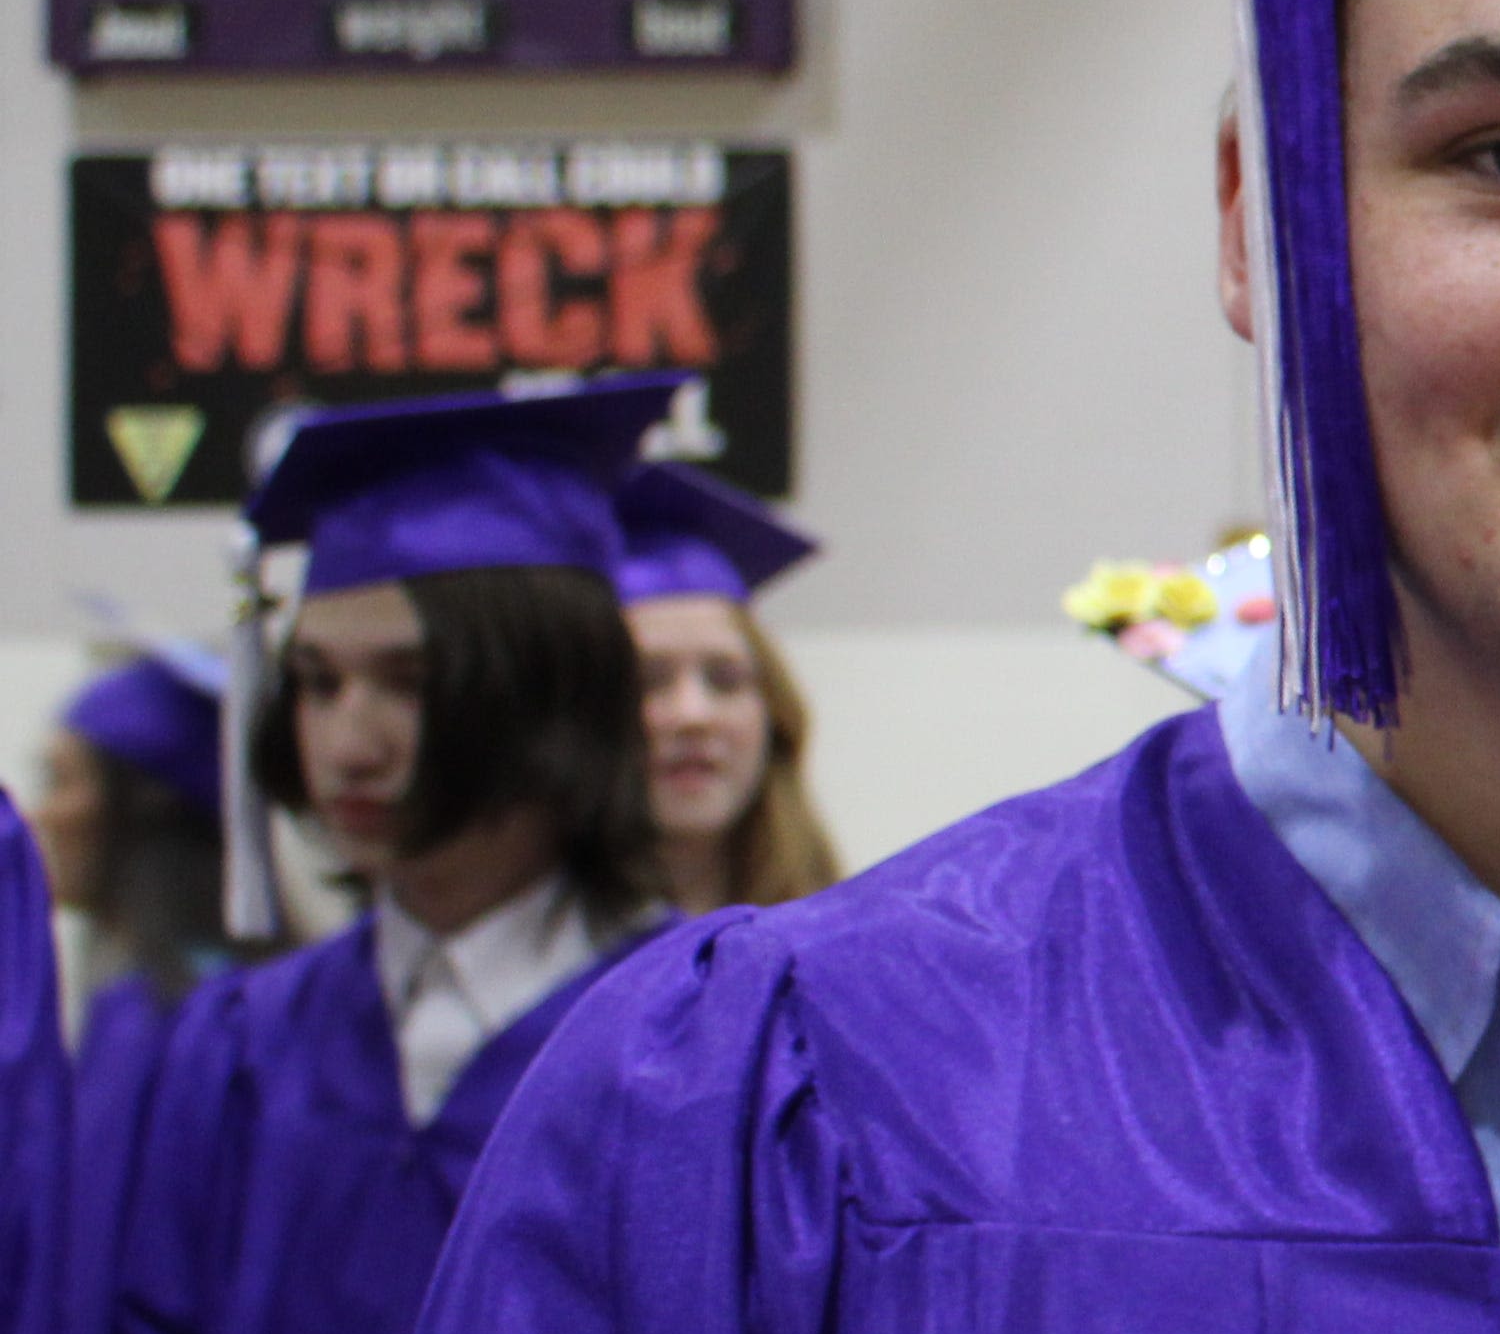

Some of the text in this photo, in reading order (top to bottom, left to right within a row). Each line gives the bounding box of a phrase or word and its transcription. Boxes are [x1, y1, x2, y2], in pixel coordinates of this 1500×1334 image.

[154, 146, 246, 205] ONE
[259, 147, 369, 205] TEXT
[454, 146, 555, 204] CALL
[156, 208, 717, 369] WRECK
